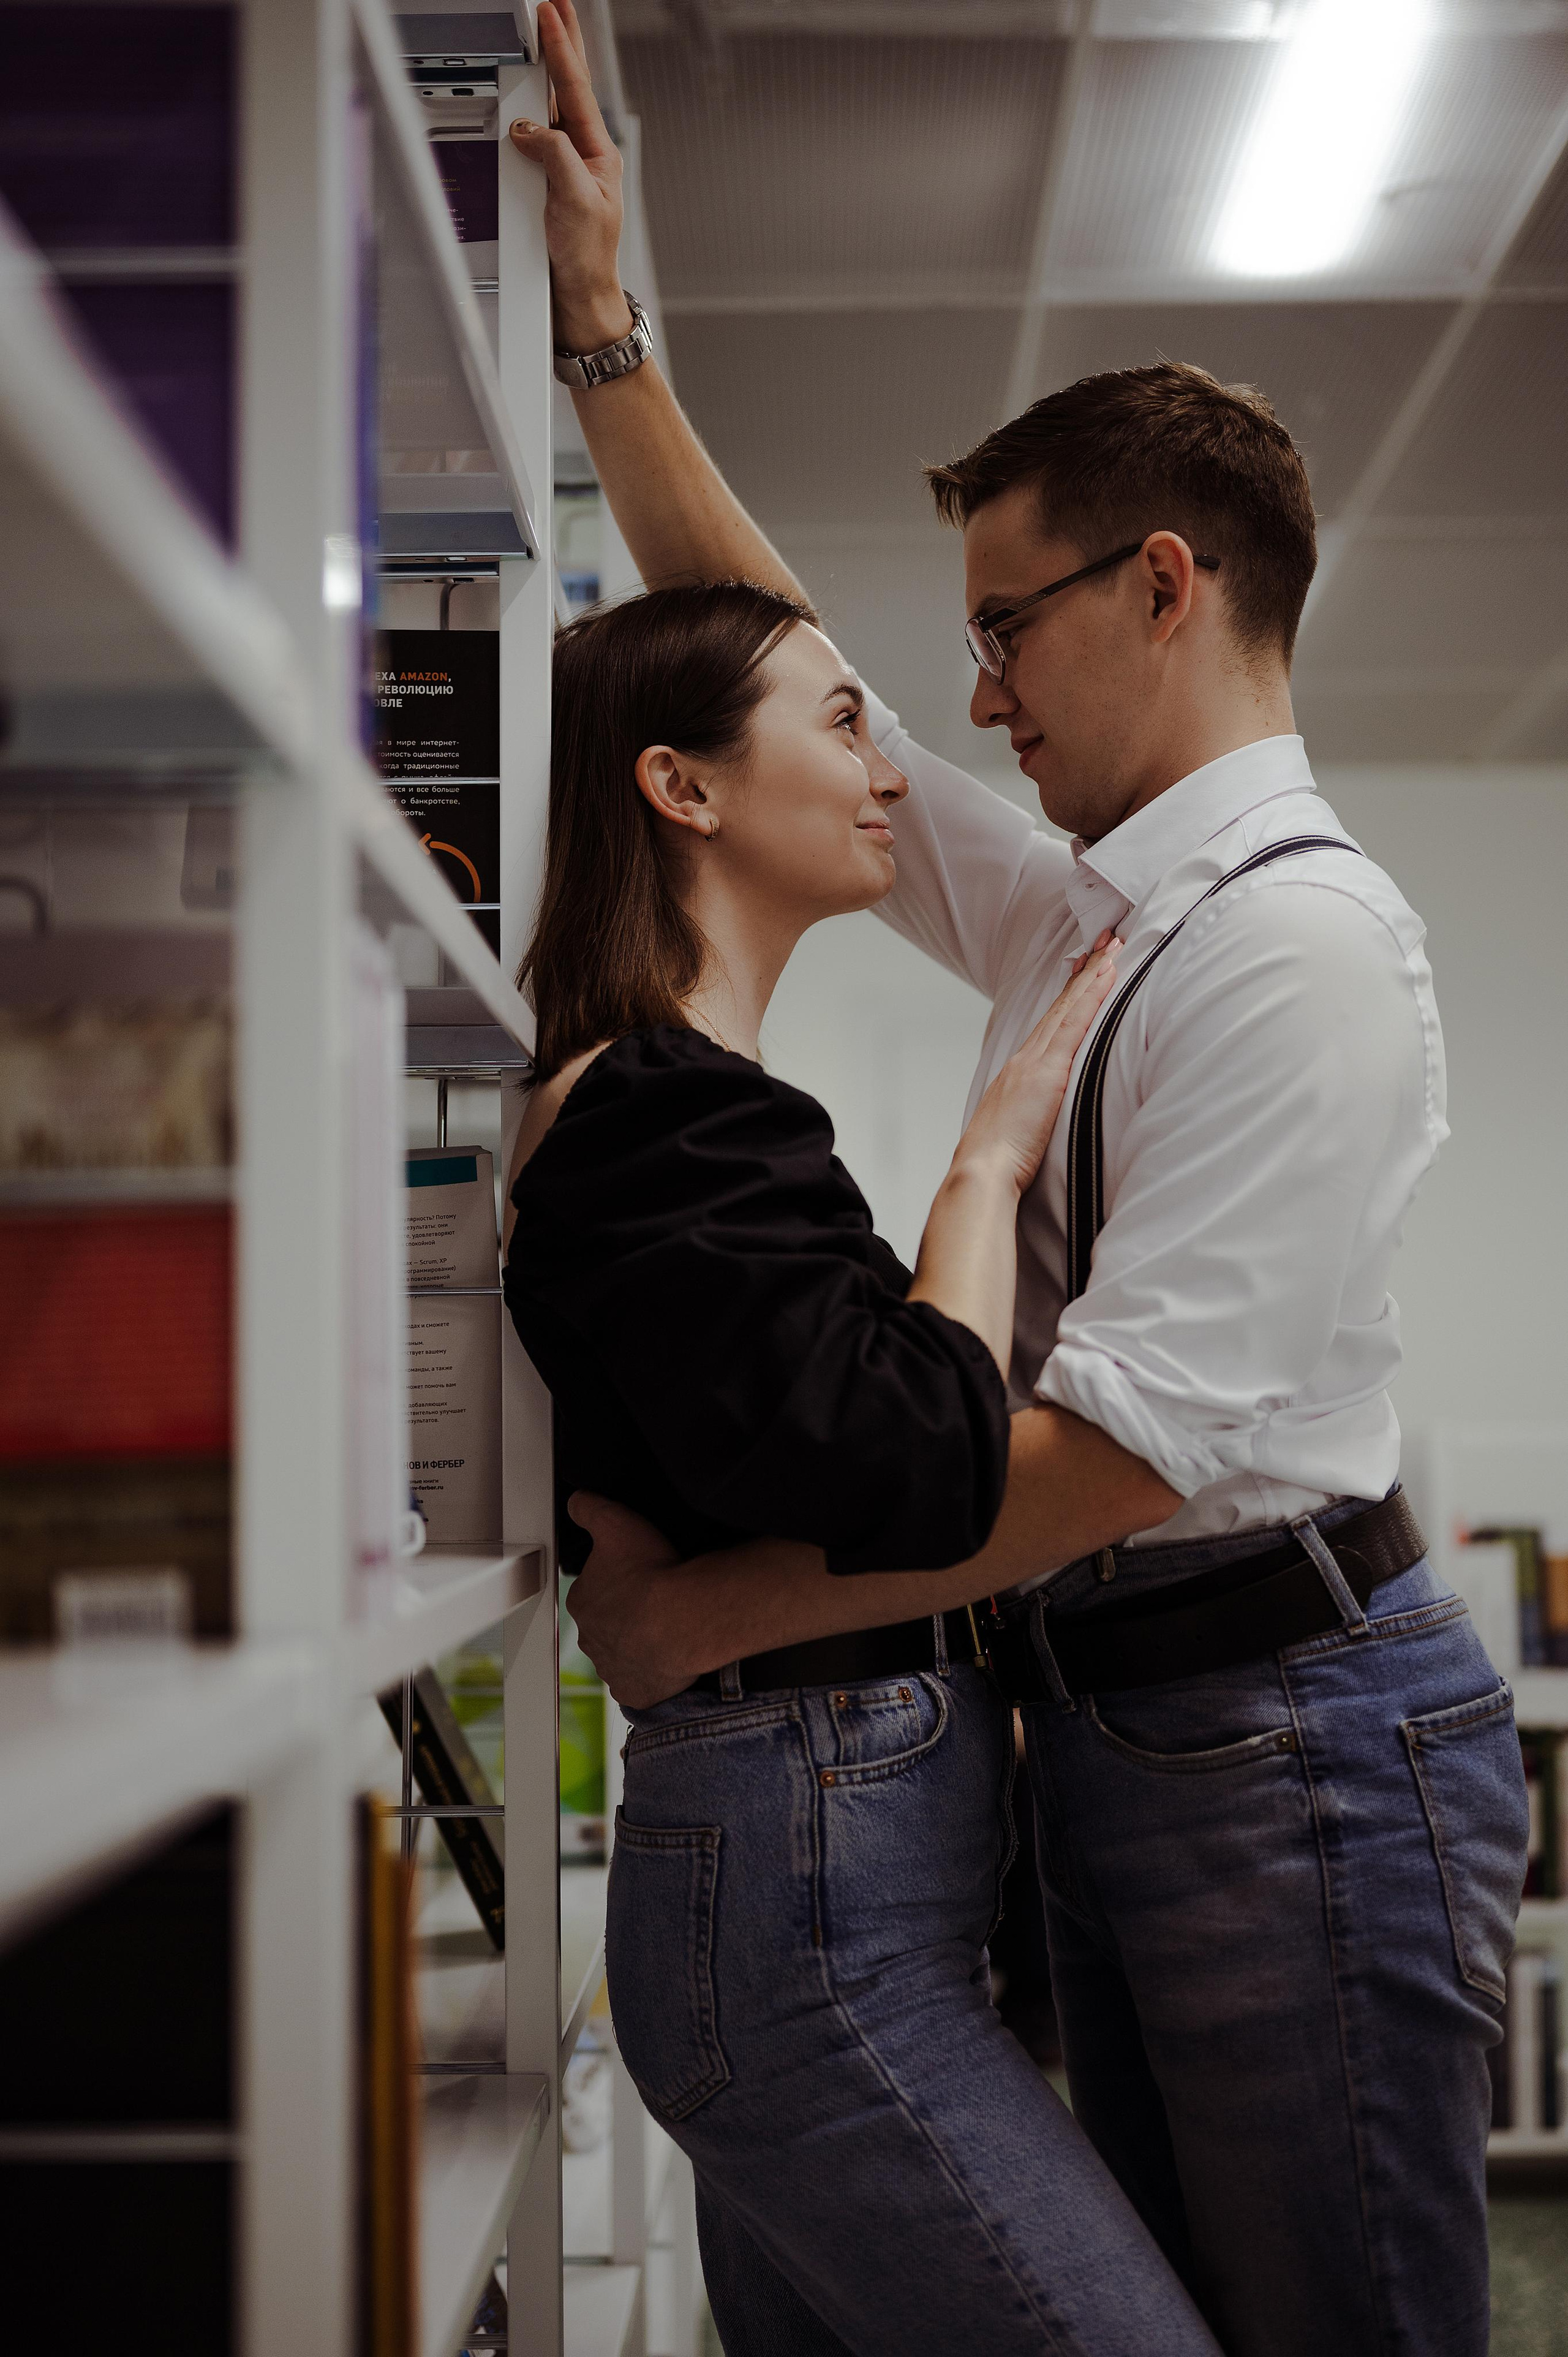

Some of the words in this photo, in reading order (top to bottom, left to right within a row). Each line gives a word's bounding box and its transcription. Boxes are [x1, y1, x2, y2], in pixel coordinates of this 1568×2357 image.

[375, 672, 396, 681] ЕХА
[400, 672, 451, 683] AMAZON,
[377, 685, 453, 696] РЕВОЛЮЦИЮ
[374, 698, 403, 707] ОВЛЕ
[412, 1230, 455, 1239] удовлетворяют
[423, 1461, 429, 1469] И
[430, 1459, 464, 1469] ФЕРБЕР
